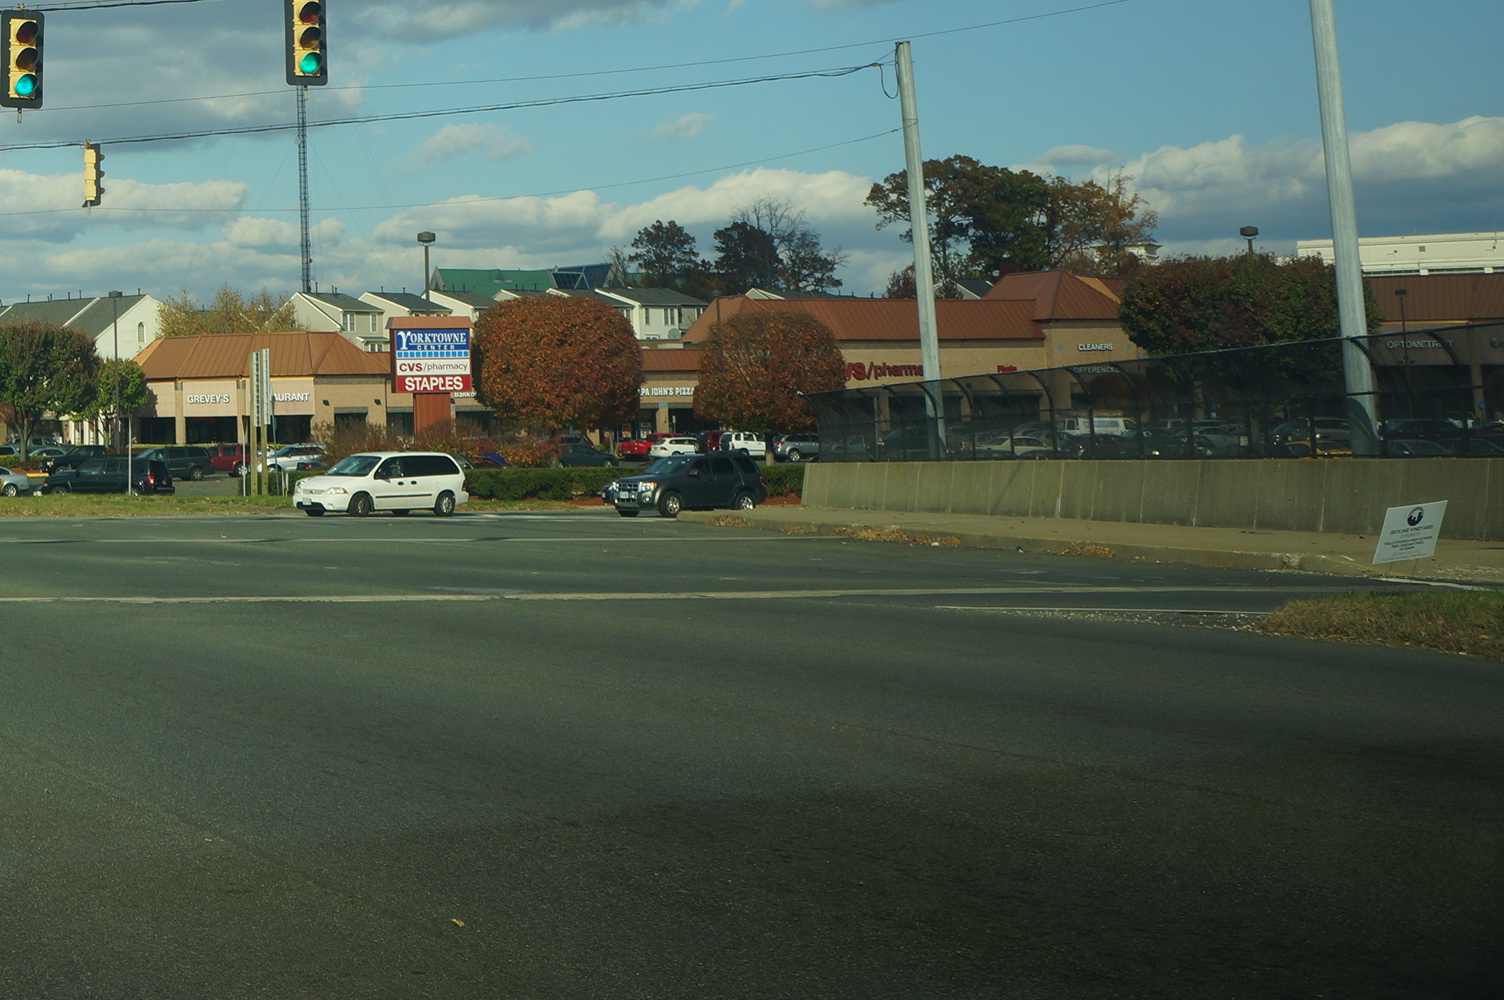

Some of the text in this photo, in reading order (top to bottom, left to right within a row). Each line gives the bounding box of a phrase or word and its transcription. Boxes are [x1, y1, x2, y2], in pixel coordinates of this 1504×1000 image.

[397, 330, 467, 350] YORKTOWNE
[1386, 340, 1453, 349] OPTOMETRIT
[1078, 343, 1113, 351] CLEANERS
[399, 362, 468, 373] CVS/pharmacy
[404, 376, 464, 392] STAPLES
[651, 387, 674, 396] JOHN'S
[187, 392, 310, 404] GREVEY'S AURANT
